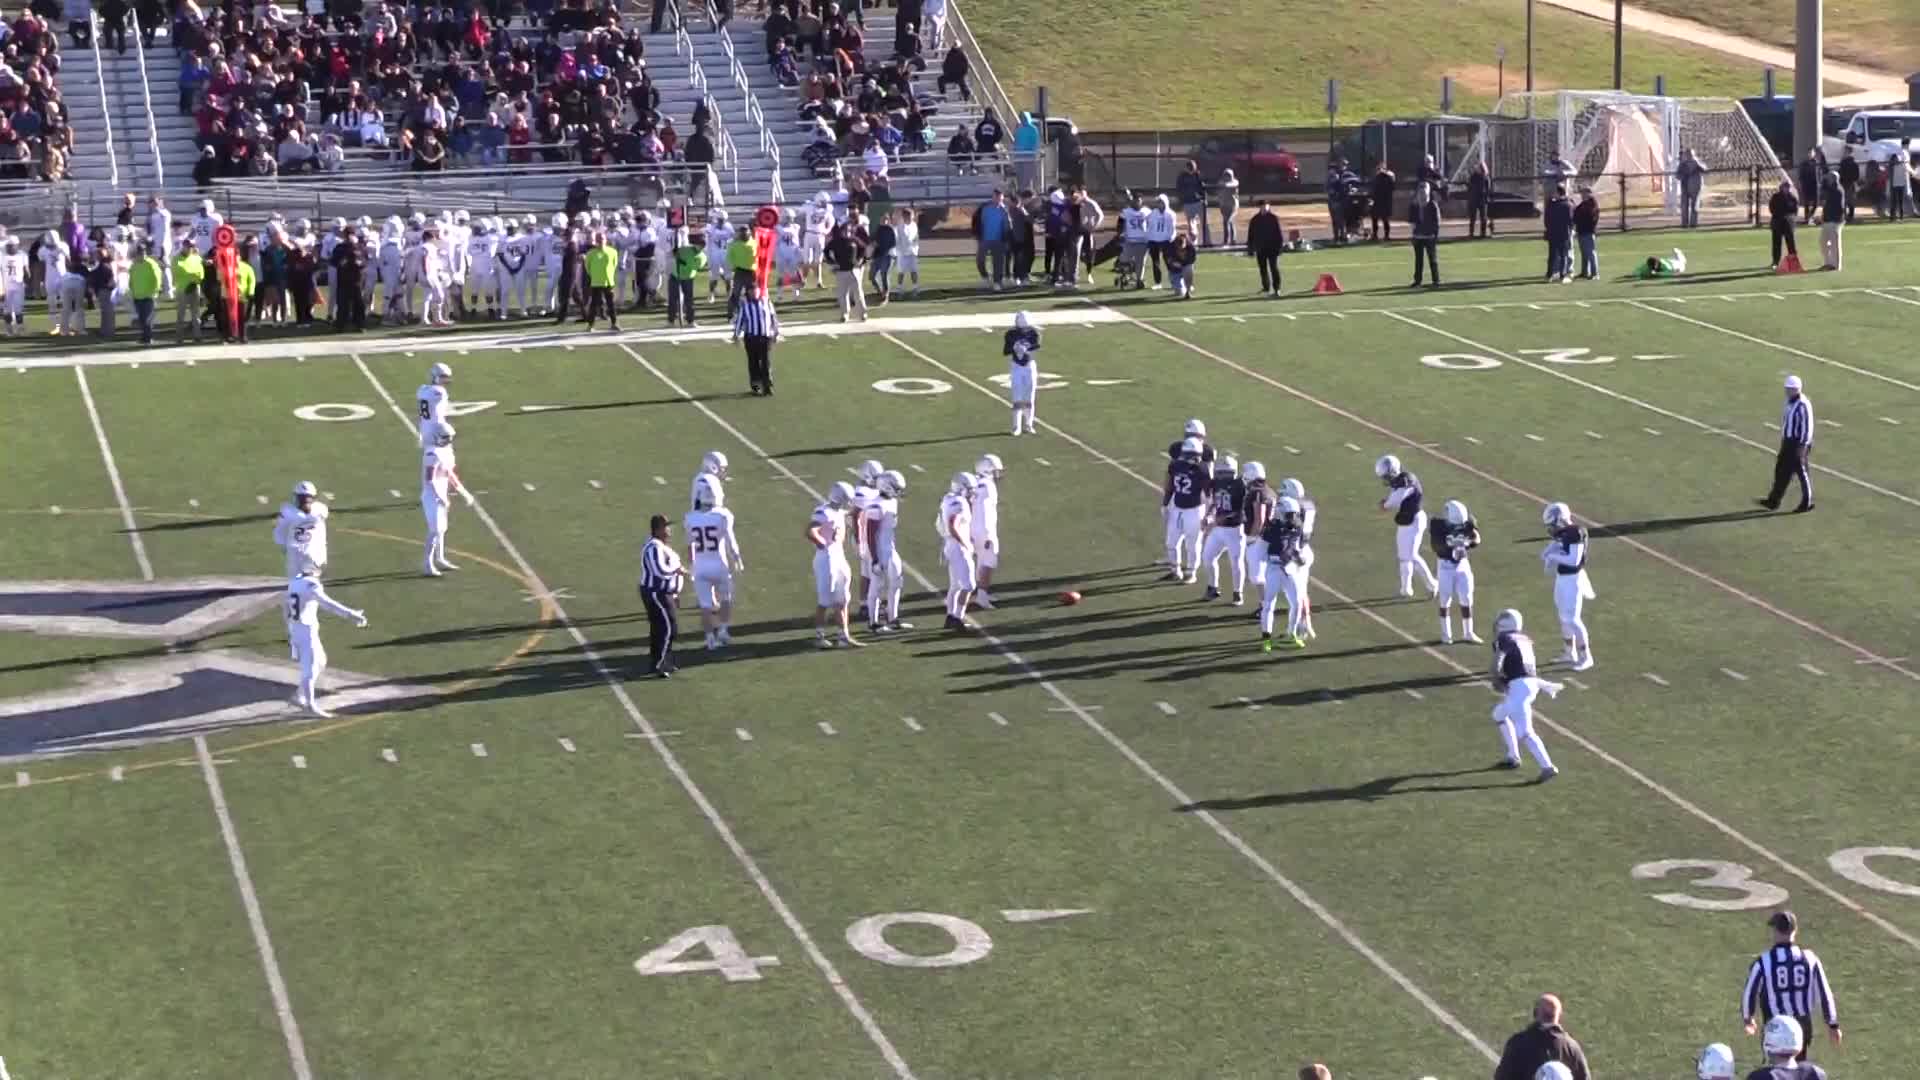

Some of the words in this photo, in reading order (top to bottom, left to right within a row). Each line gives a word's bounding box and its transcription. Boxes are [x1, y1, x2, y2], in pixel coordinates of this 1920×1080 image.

[1174, 474, 1193, 494] 52
[691, 526, 719, 552] 35
[1776, 966, 1805, 988] 86
